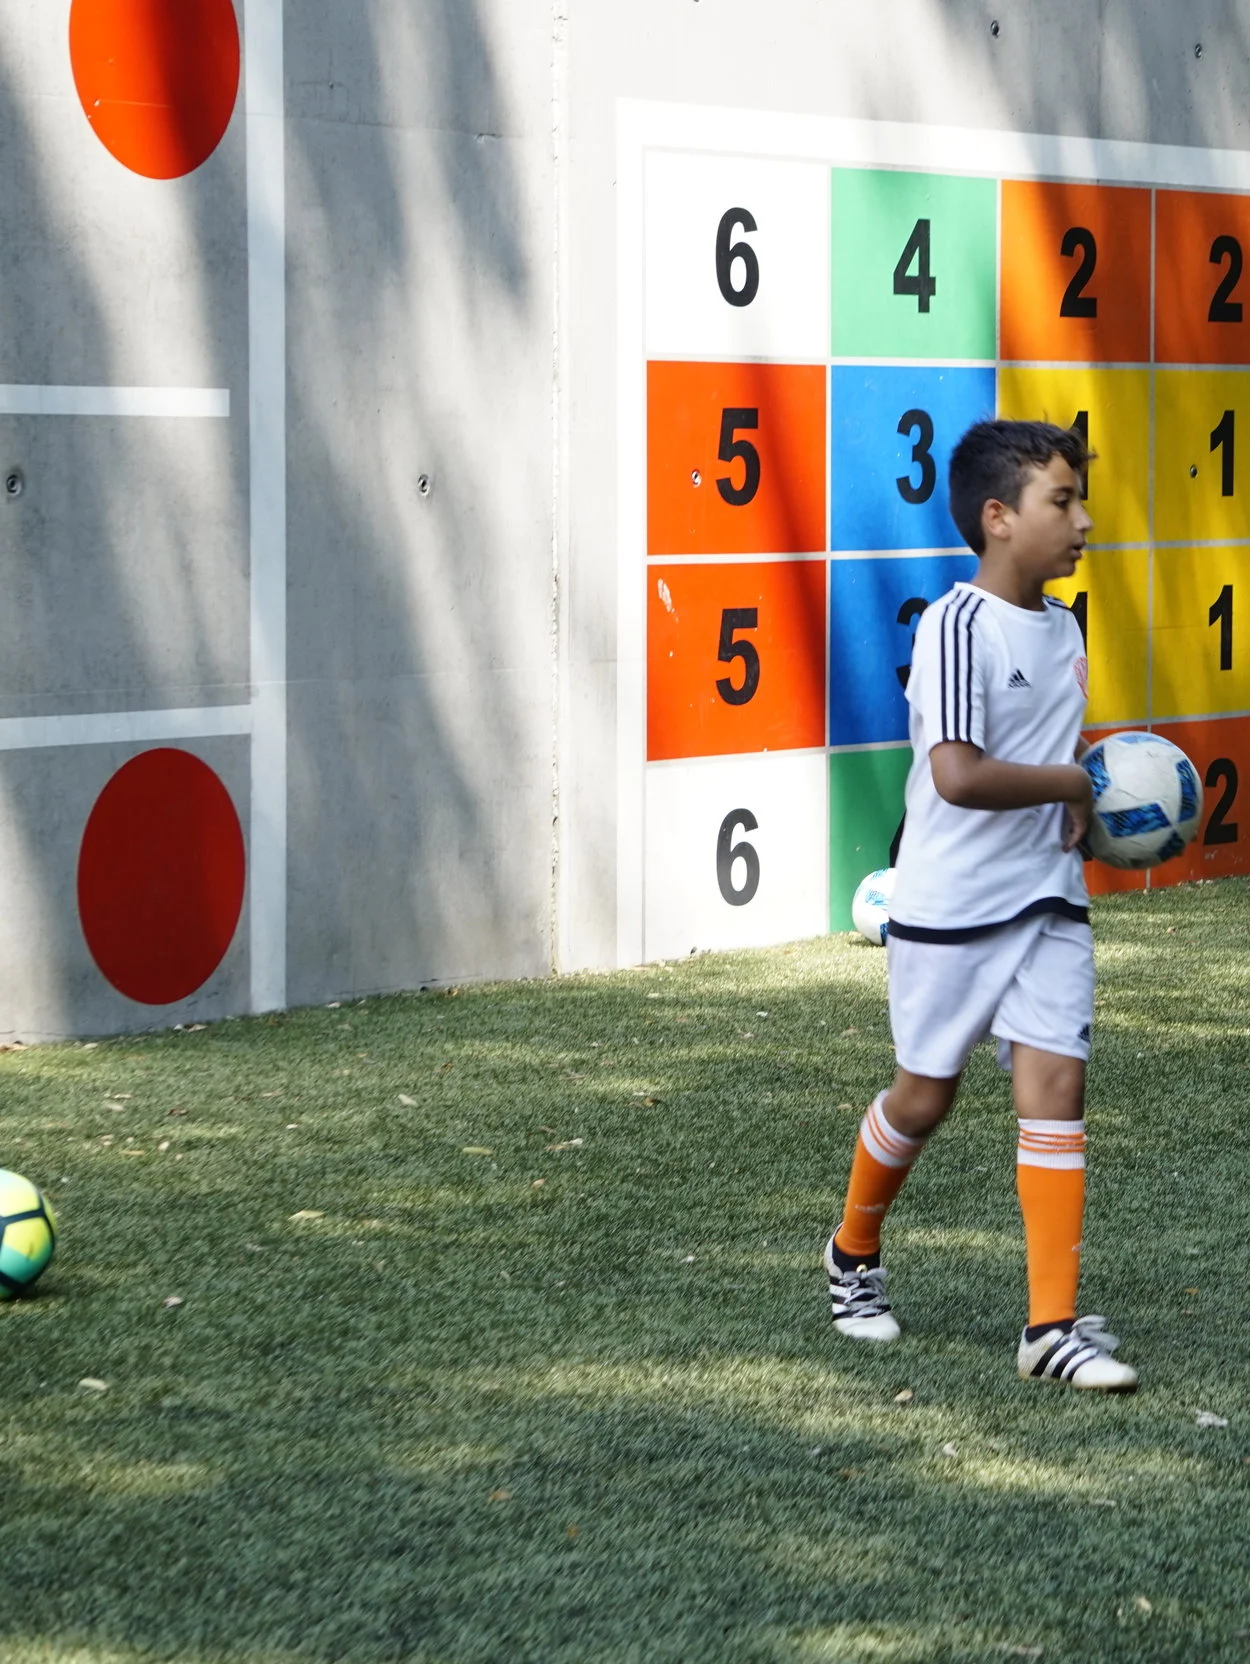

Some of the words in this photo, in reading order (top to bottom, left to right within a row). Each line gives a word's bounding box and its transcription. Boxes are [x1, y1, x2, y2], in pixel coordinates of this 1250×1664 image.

[716, 206, 760, 307] 6
[893, 218, 936, 314] 4
[1060, 227, 1098, 318] 2
[1207, 235, 1244, 323] 2
[716, 407, 761, 506] 5
[896, 409, 937, 504] 3
[1210, 410, 1236, 497] 1
[715, 607, 760, 706] 5
[1208, 584, 1233, 671] 1
[716, 808, 760, 907] 6
[1203, 757, 1239, 846] 2
